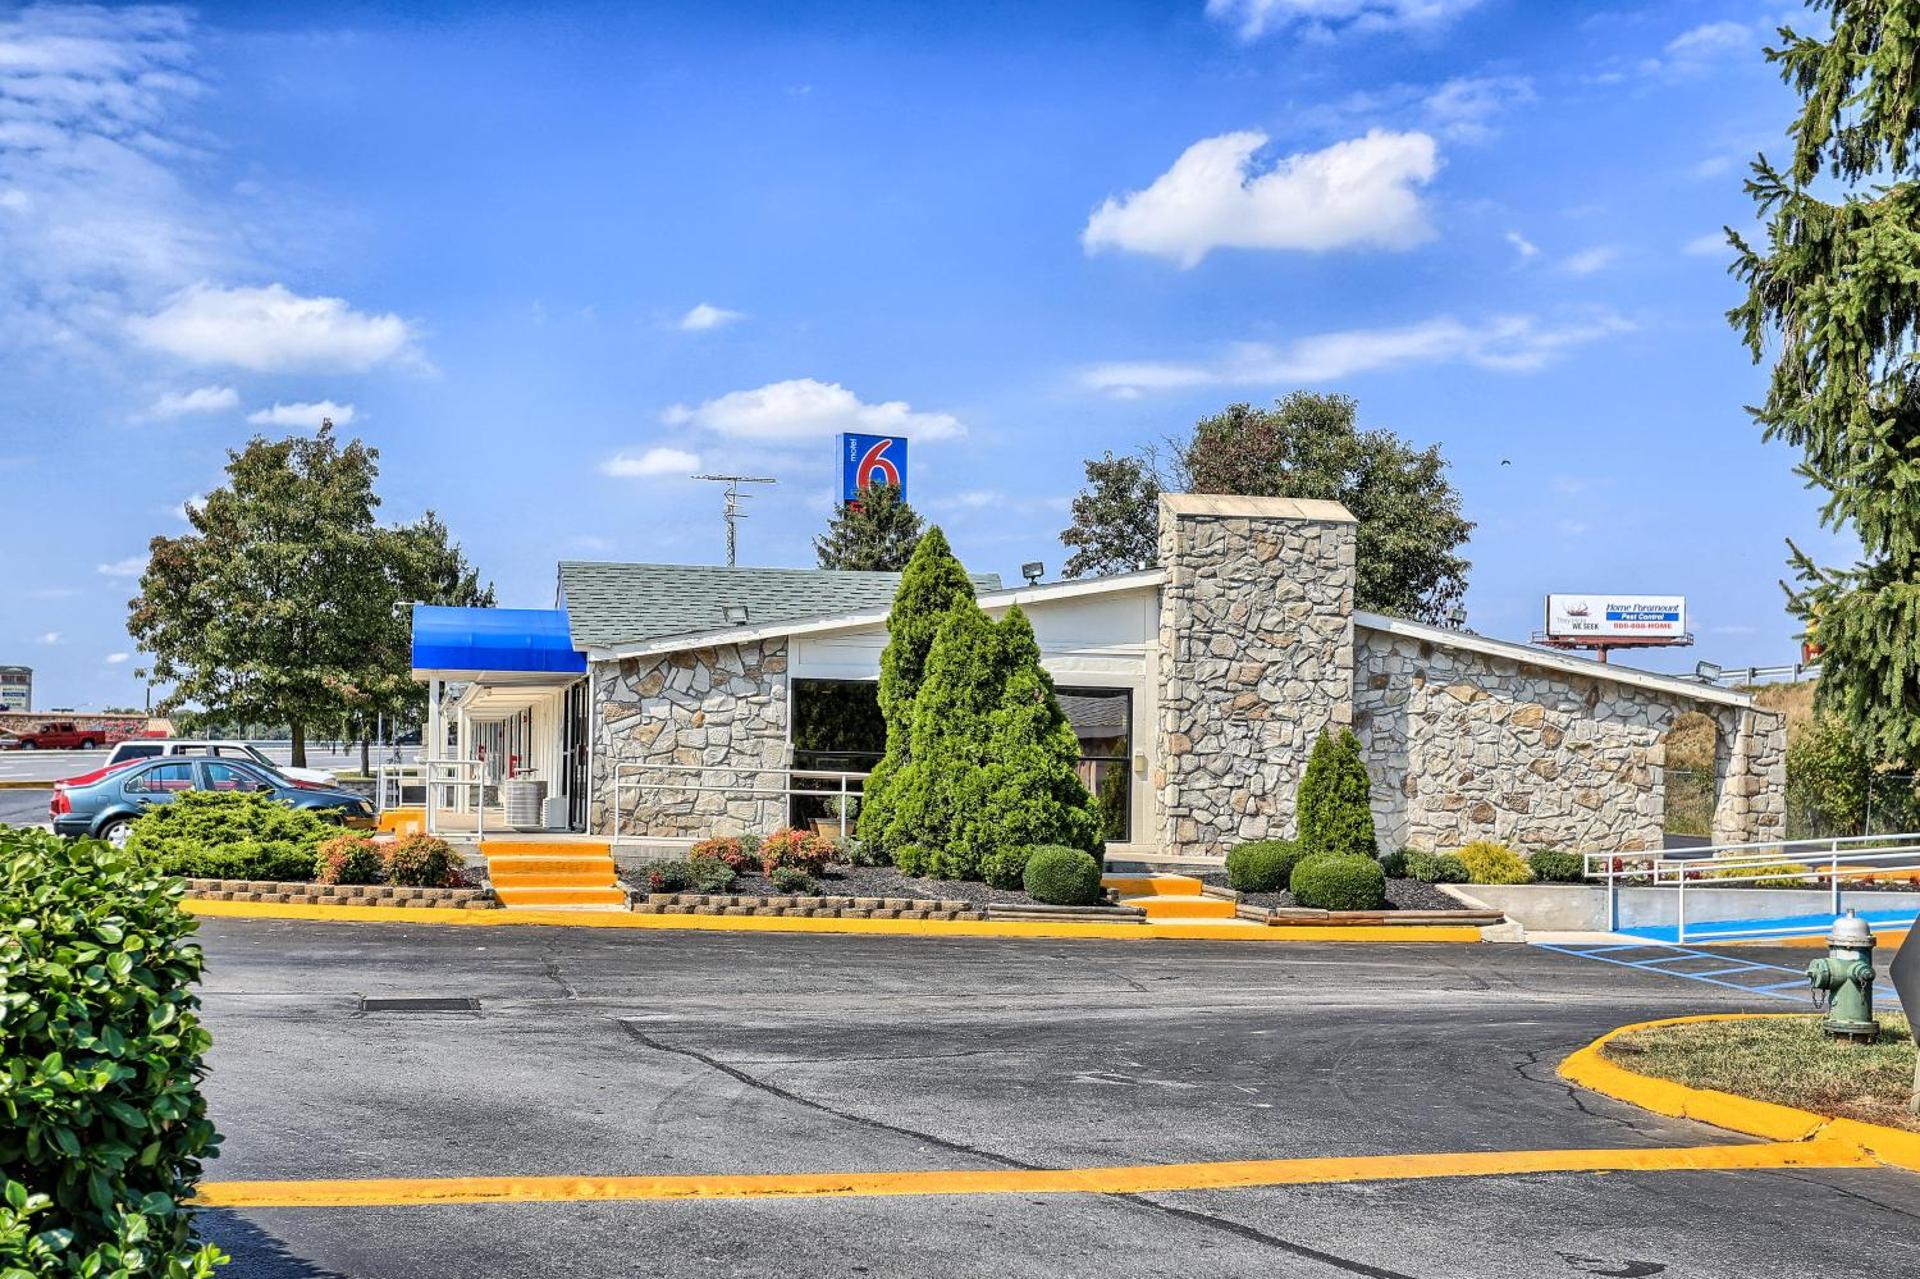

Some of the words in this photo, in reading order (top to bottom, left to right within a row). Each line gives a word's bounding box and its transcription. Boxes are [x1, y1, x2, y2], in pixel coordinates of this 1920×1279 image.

[856, 439, 901, 494] 6
[1632, 603, 1679, 611] Paramount
[1621, 612, 1637, 620] Pest
[1583, 622, 1600, 630] SEEK
